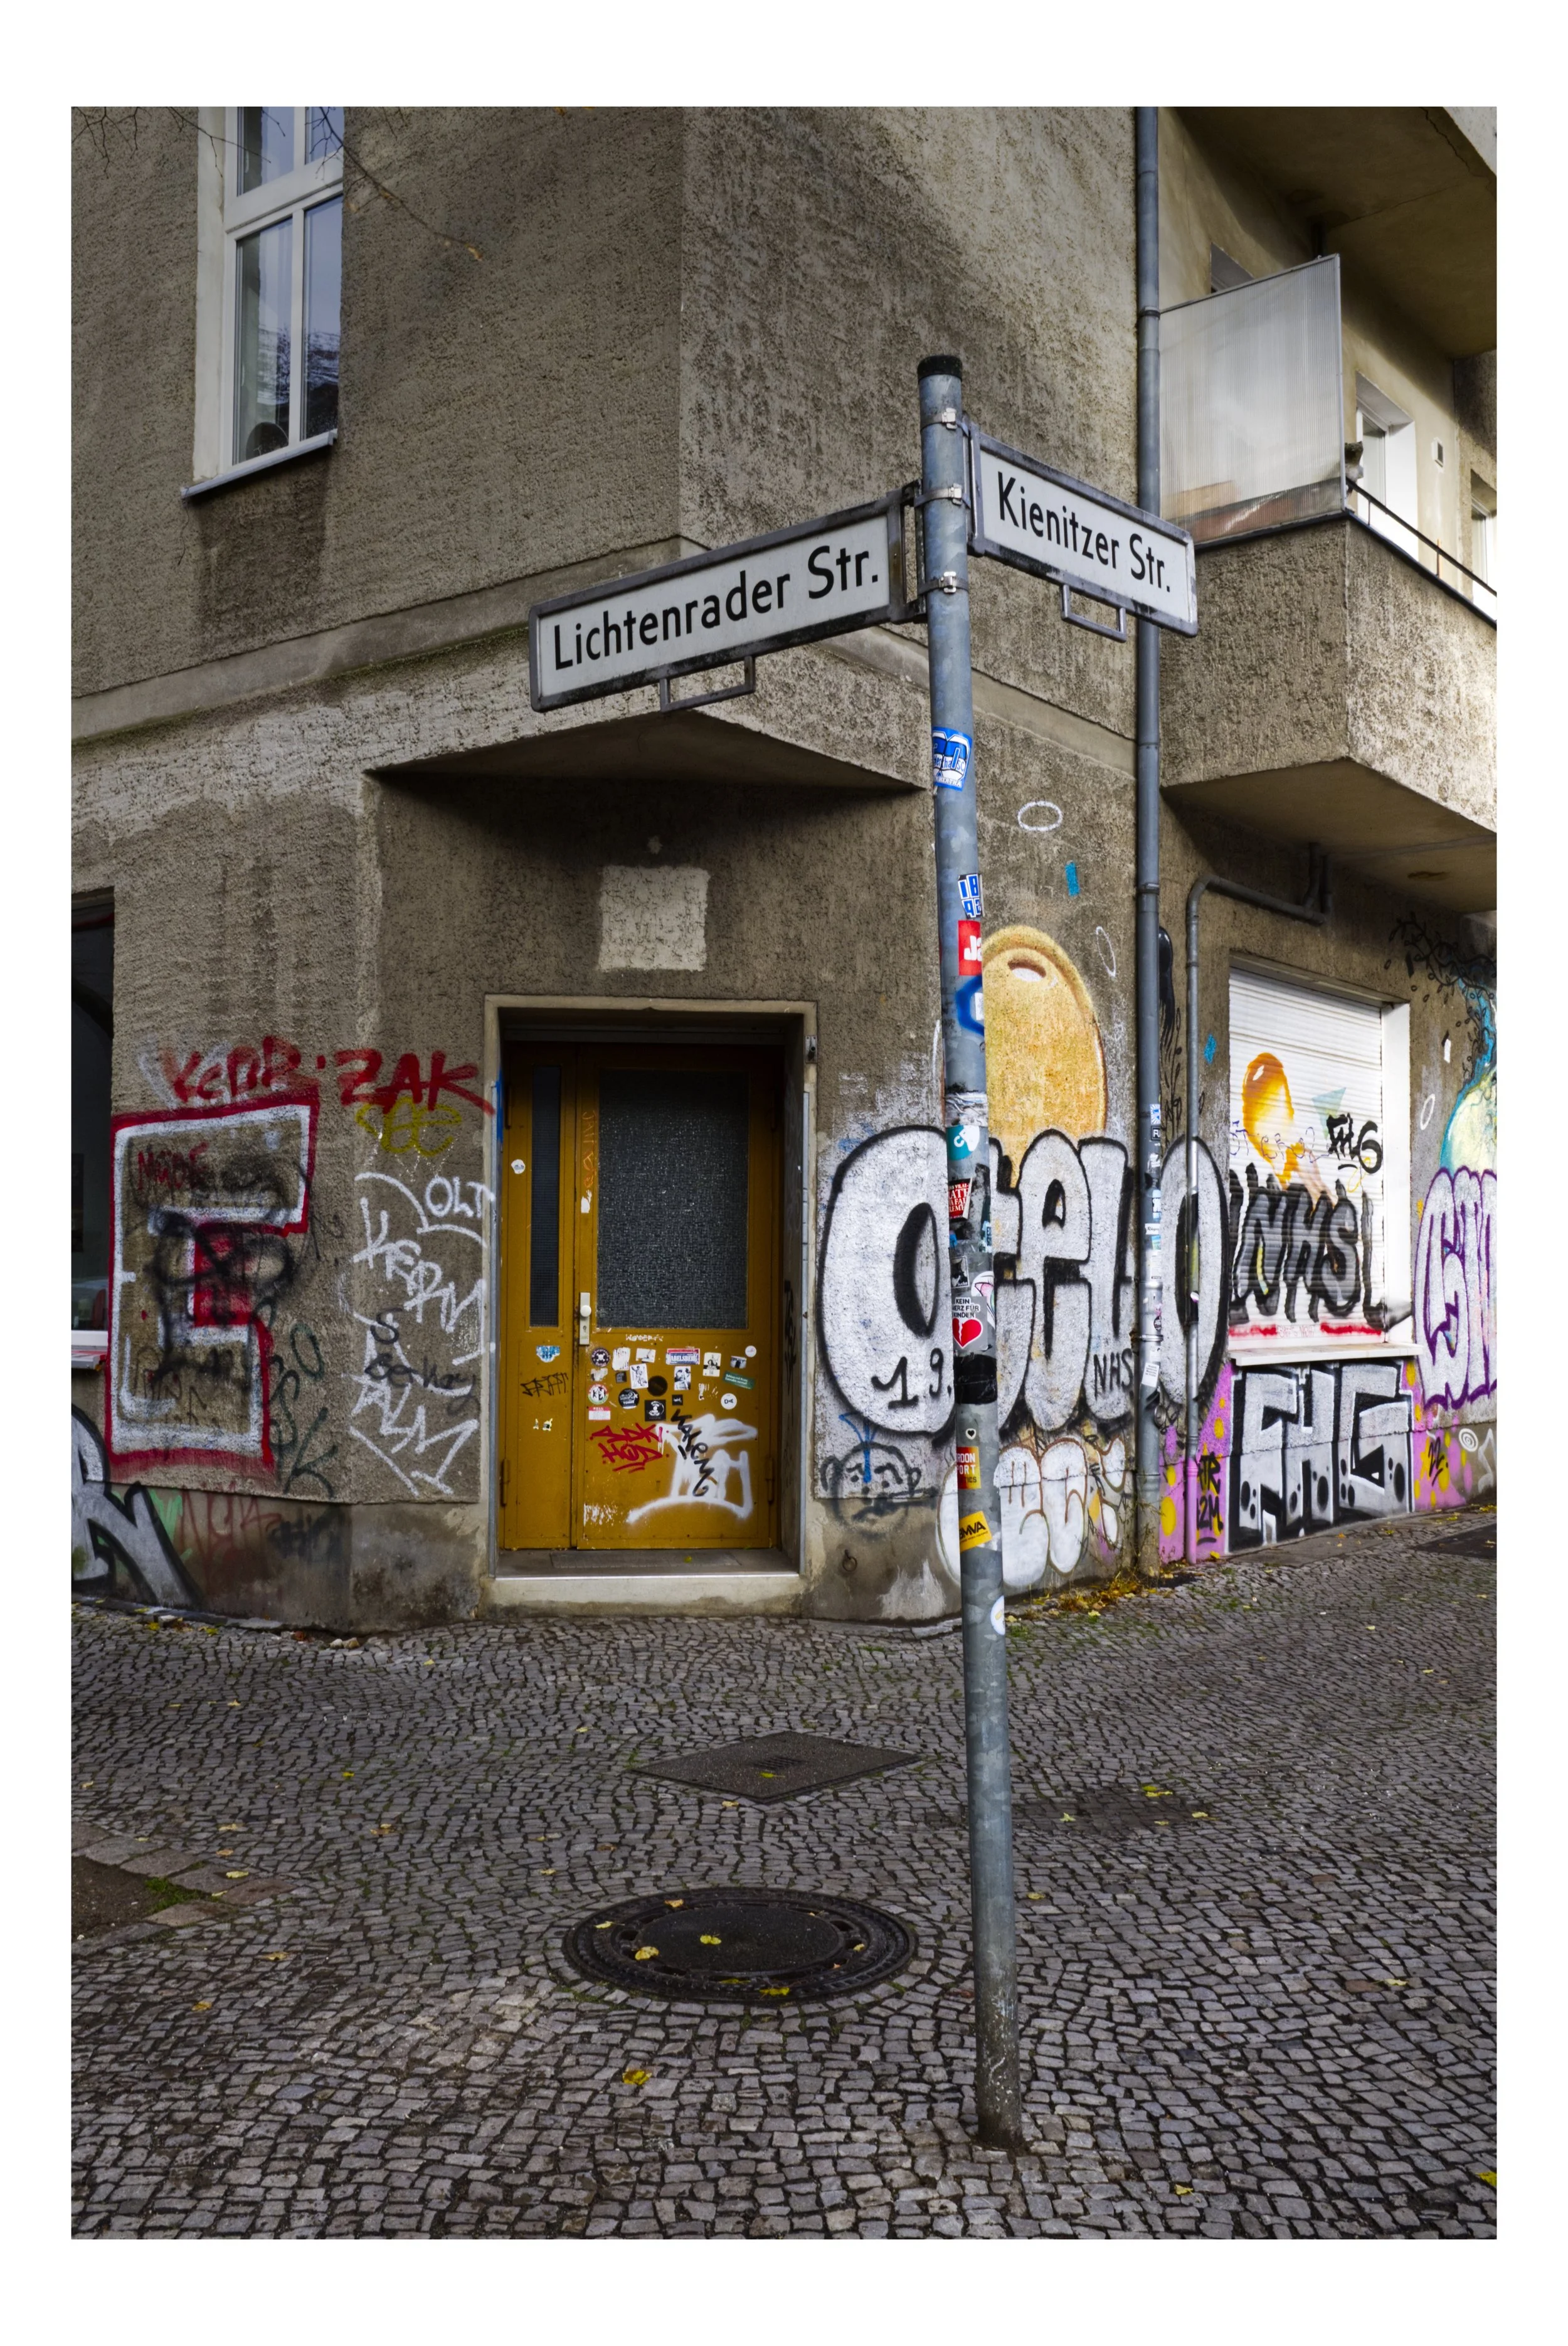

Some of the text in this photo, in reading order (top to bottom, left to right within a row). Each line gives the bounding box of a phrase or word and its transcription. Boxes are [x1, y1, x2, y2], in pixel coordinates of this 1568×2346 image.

[997, 470, 1172, 593] Kienitzer Str.
[553, 545, 878, 671] Lichtenrader Str.
